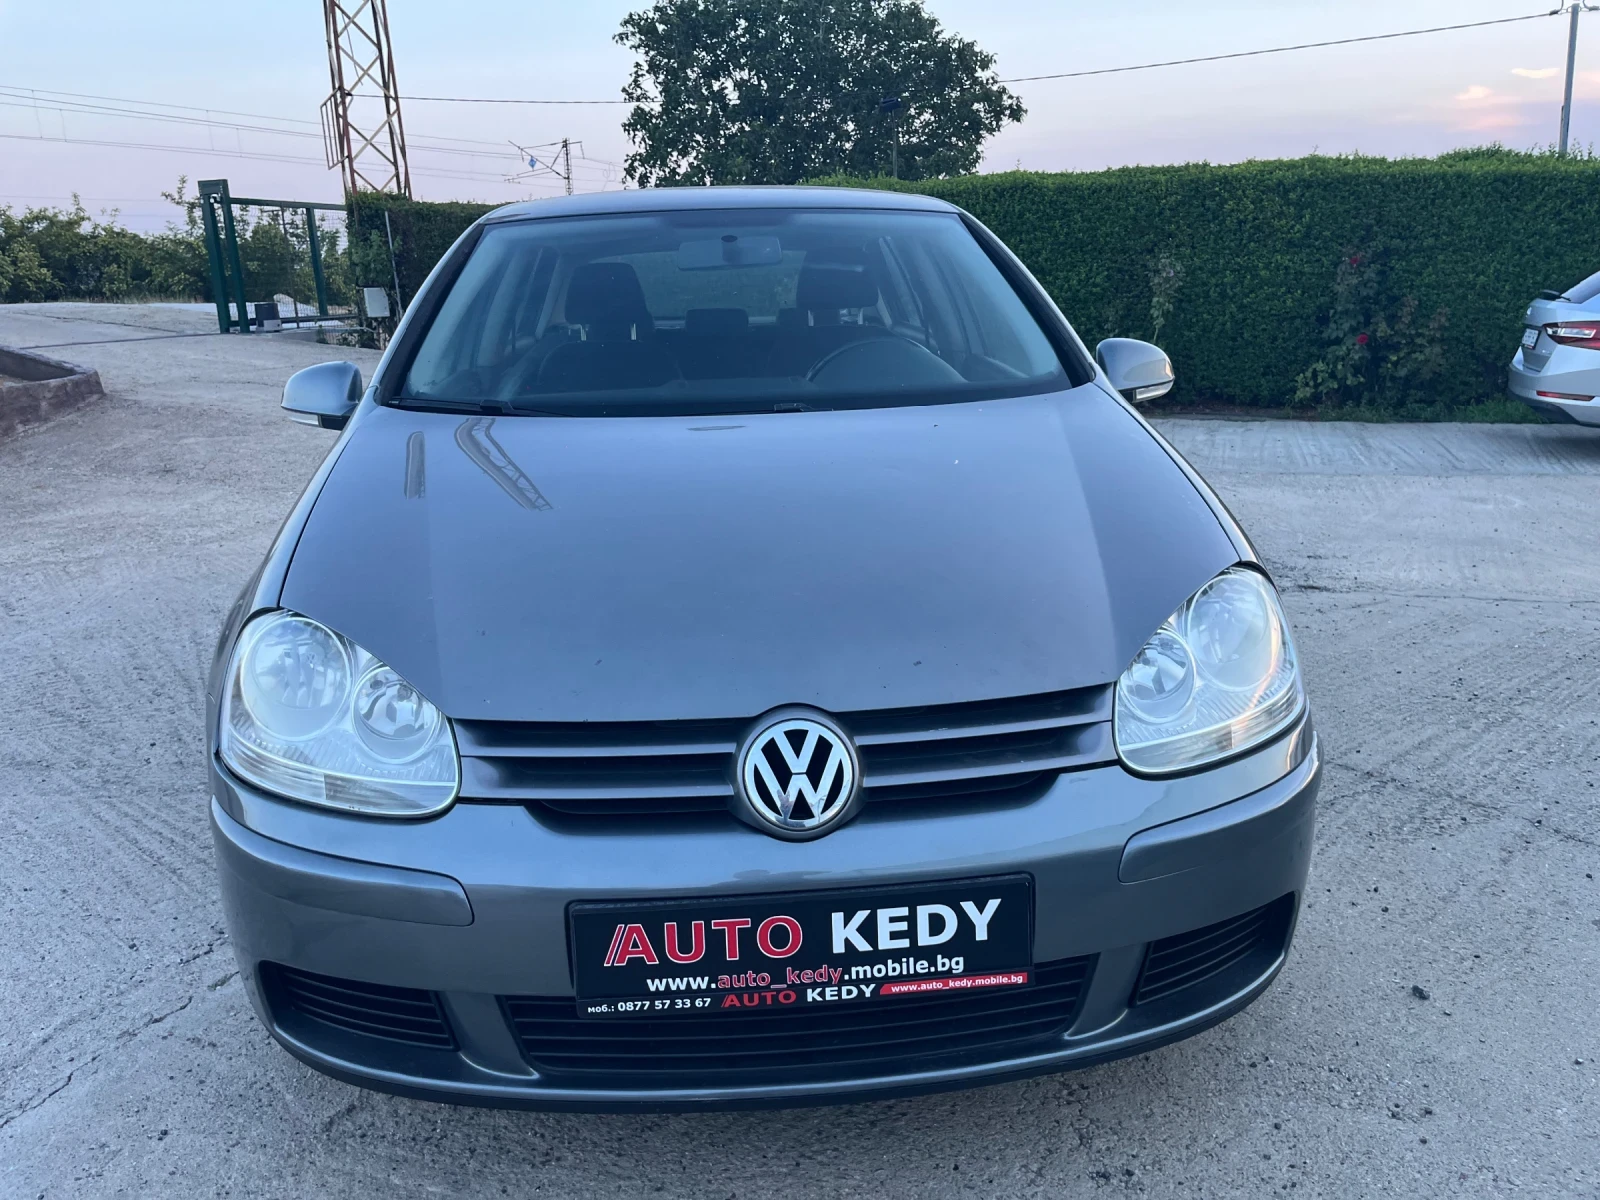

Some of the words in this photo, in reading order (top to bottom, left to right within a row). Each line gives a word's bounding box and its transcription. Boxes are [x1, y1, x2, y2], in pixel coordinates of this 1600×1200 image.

[604, 915, 803, 966] AUTO
[831, 898, 1002, 954] KEDY
[646, 954, 965, 992] www.auto_kedy.mobile.bg
[891, 974, 1024, 993] www.auto_kedy.mobile.bg
[617, 1001, 650, 1012] 0877
[654, 1000, 670, 1010] 57
[674, 998, 691, 1009] 33
[695, 997, 711, 1007] 67
[721, 990, 797, 1008] AUTO
[806, 983, 876, 1002] KEDY
